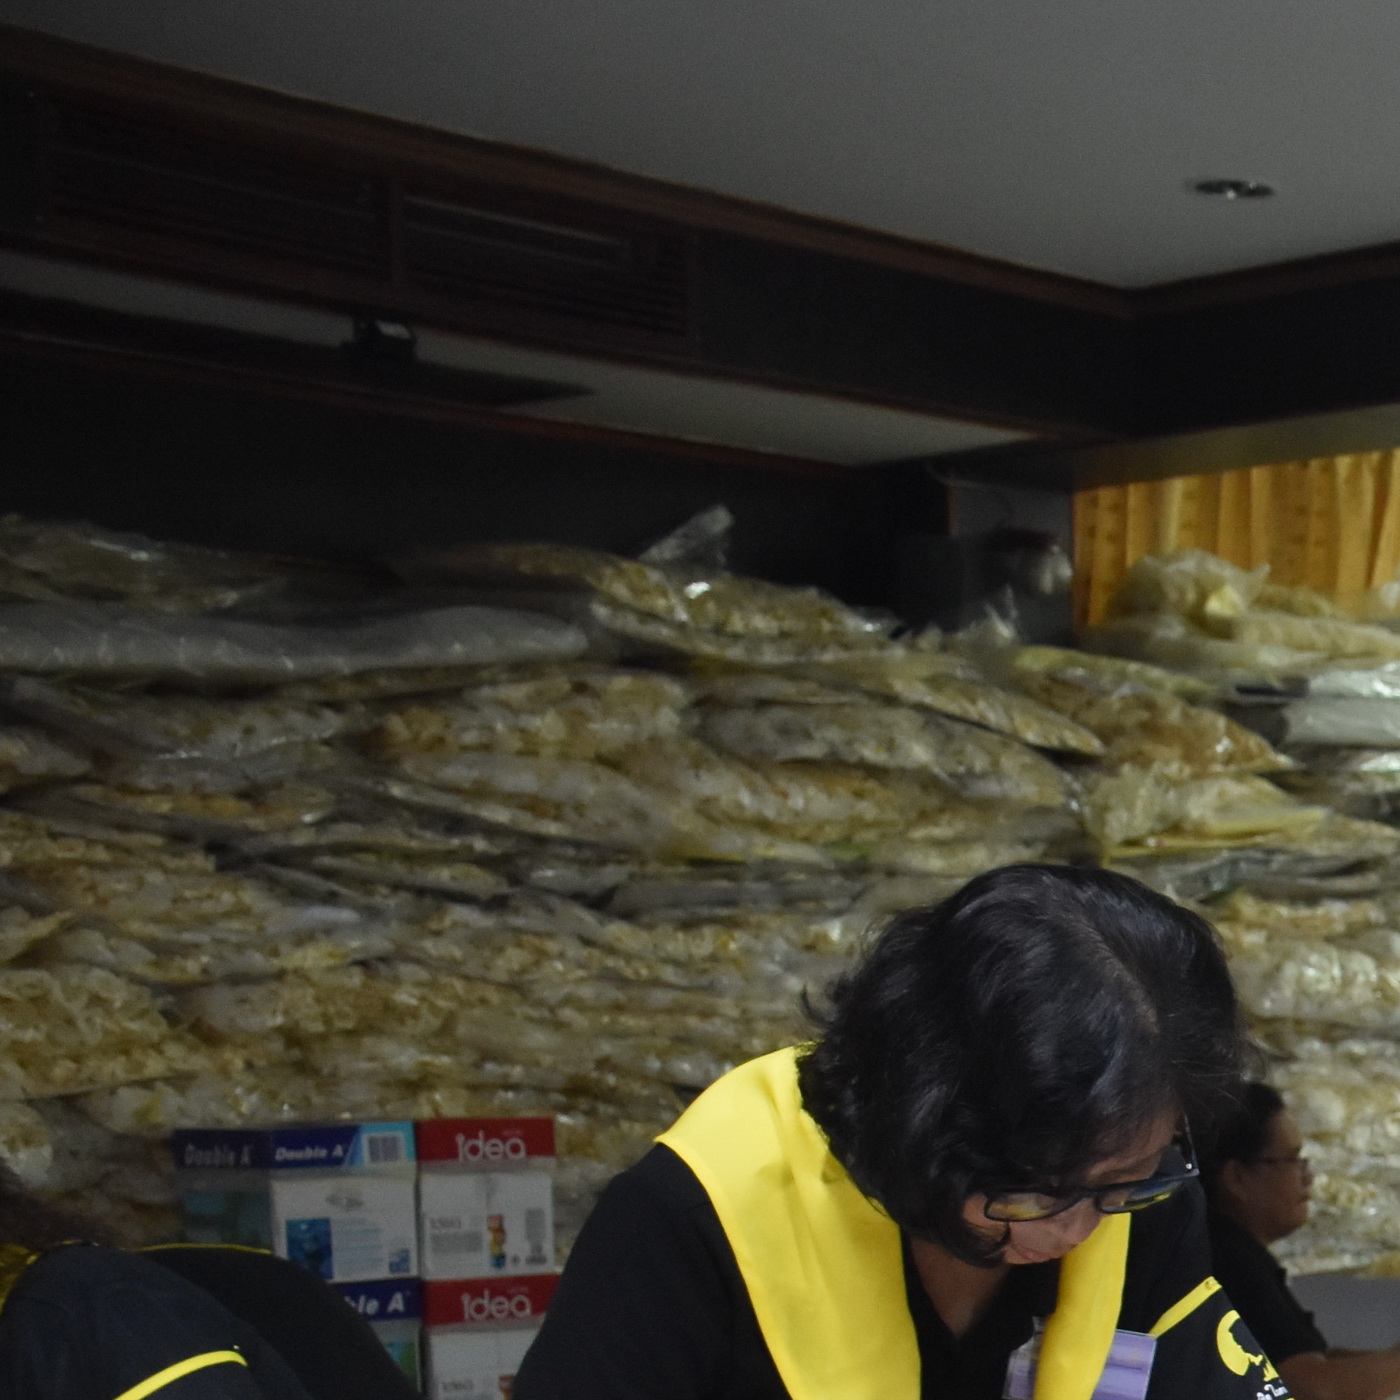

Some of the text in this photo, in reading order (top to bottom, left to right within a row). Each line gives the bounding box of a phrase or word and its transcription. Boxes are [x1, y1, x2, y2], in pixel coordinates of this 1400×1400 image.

[332, 1144, 344, 1158] A
[454, 1130, 527, 1162] idea
[461, 1288, 532, 1321] idea
